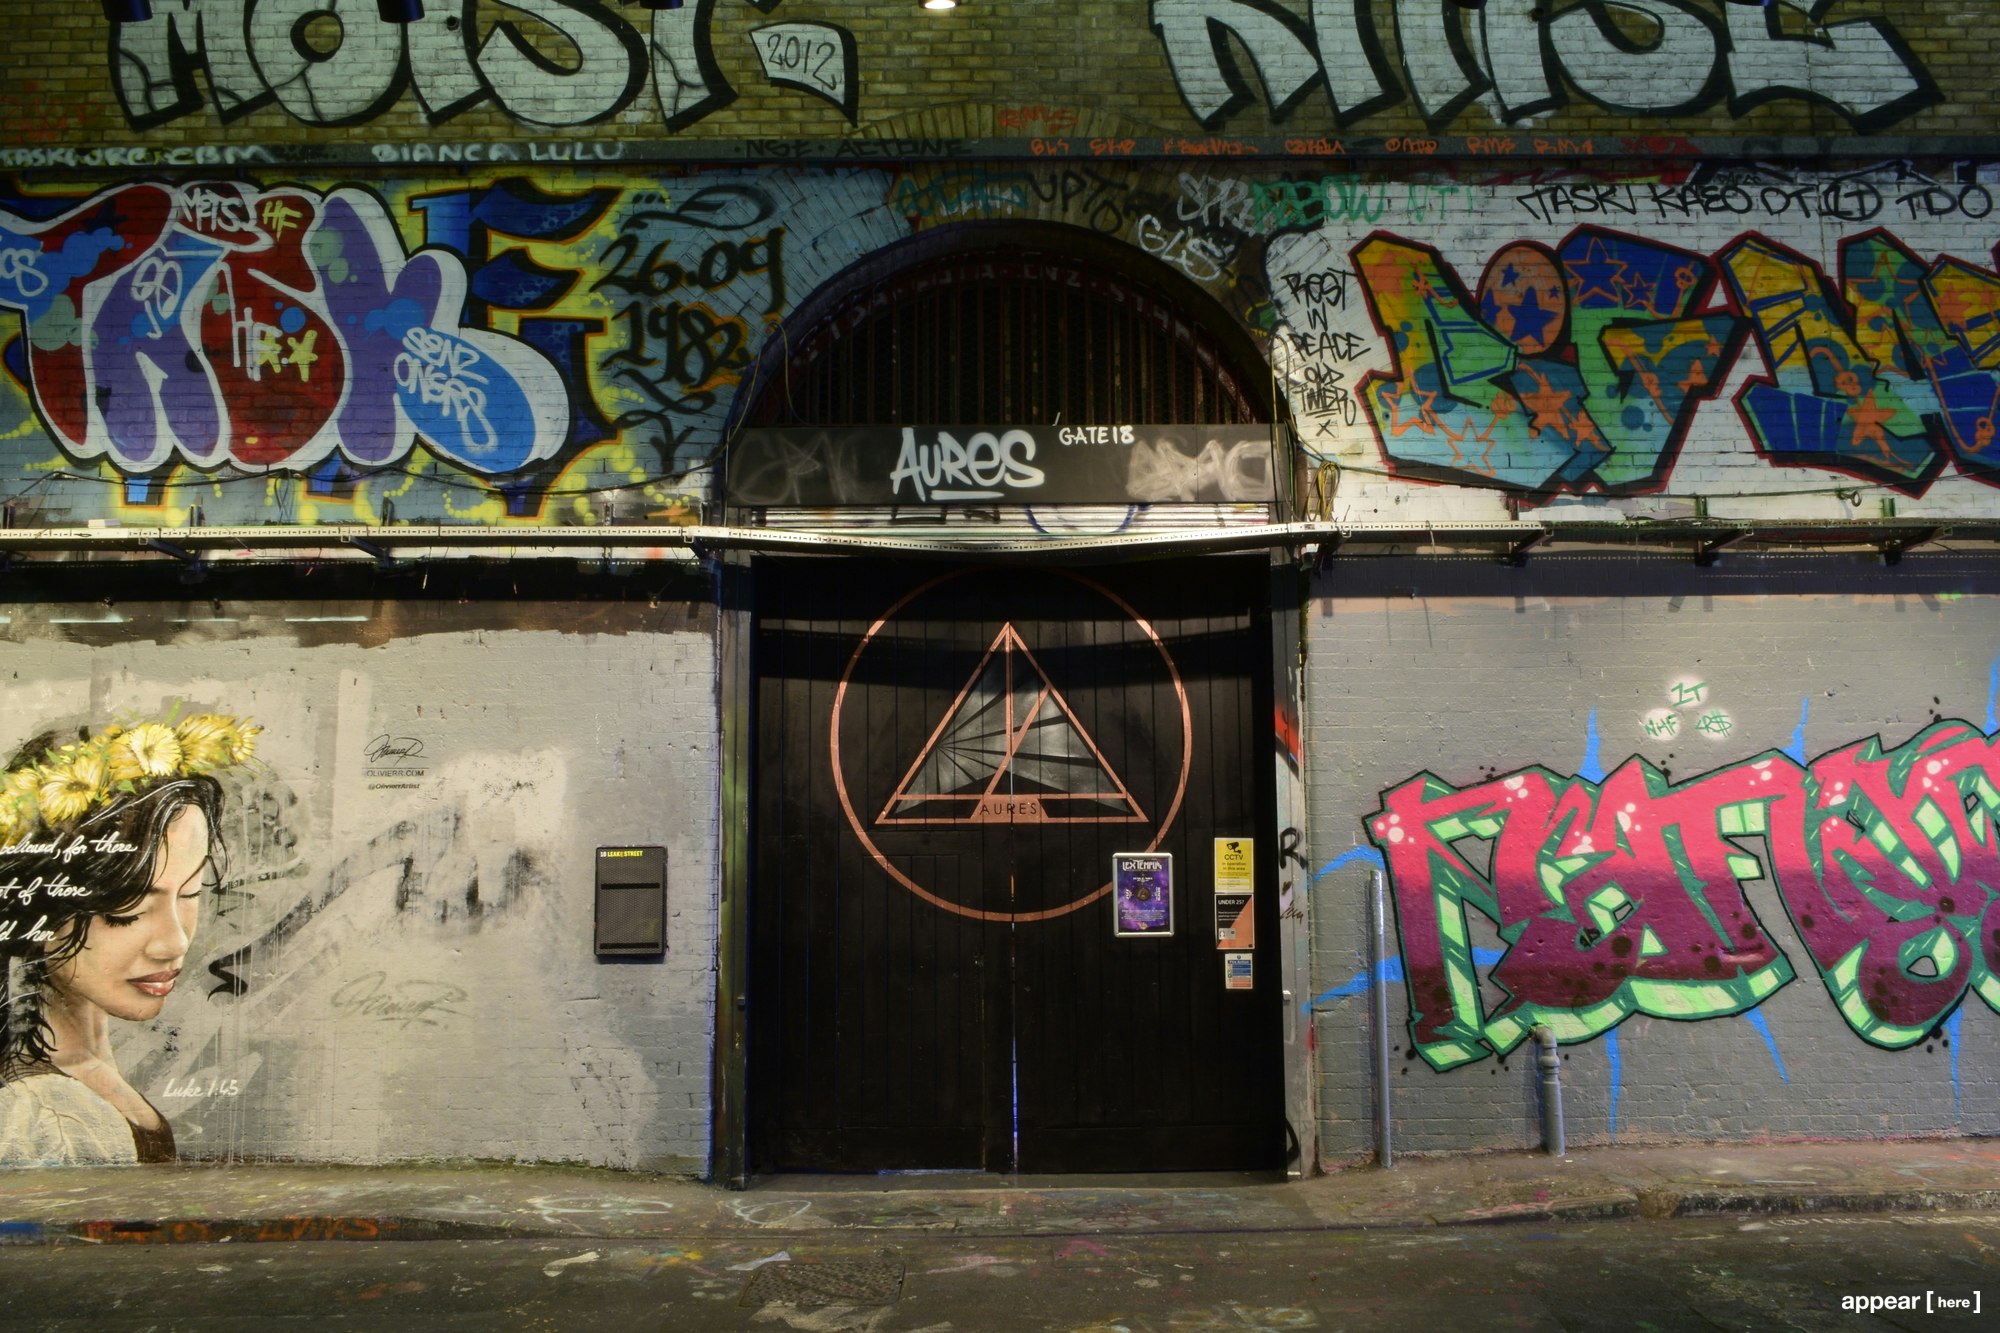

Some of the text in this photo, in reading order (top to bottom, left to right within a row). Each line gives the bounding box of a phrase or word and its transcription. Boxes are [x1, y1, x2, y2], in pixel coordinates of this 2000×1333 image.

[766, 34, 837, 90] 2012
[371, 142, 625, 162] BIANCA LULU
[1280, 267, 1357, 311] REST
[1307, 302, 1328, 332] IN
[601, 300, 753, 387] 1982
[1287, 331, 1372, 363] PEACE
[1304, 362, 1345, 386] OLD
[979, 802, 1038, 816] AURES
[62, 834, 88, 864] for
[1224, 853, 1244, 861] CCTV
[18, 876, 44, 907] of
[18, 914, 58, 942] her
[162, 1076, 240, 1098] Luke 1:45
